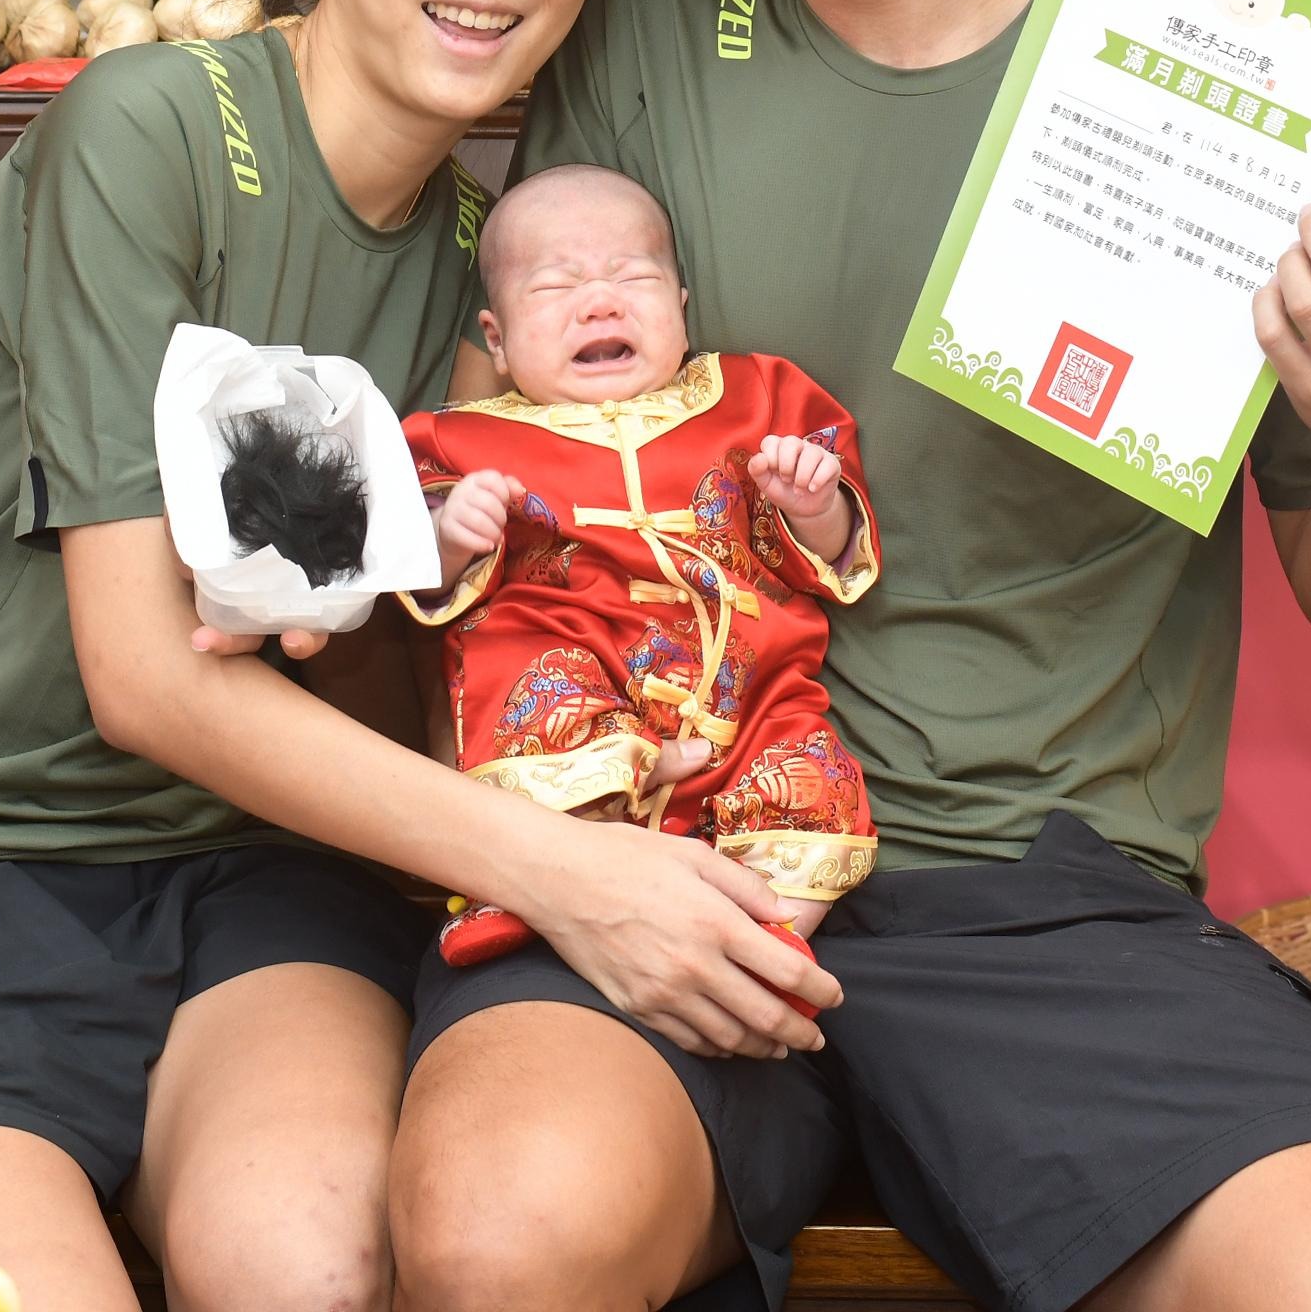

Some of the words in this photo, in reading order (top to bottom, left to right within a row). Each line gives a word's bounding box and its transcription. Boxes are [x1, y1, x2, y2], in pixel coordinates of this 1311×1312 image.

[1161, 34, 1265, 86] www.seals.com.tw
[1166, 15, 1275, 75] 傳家手工印章
[1120, 41, 1290, 137] 滿月剃頭證書
